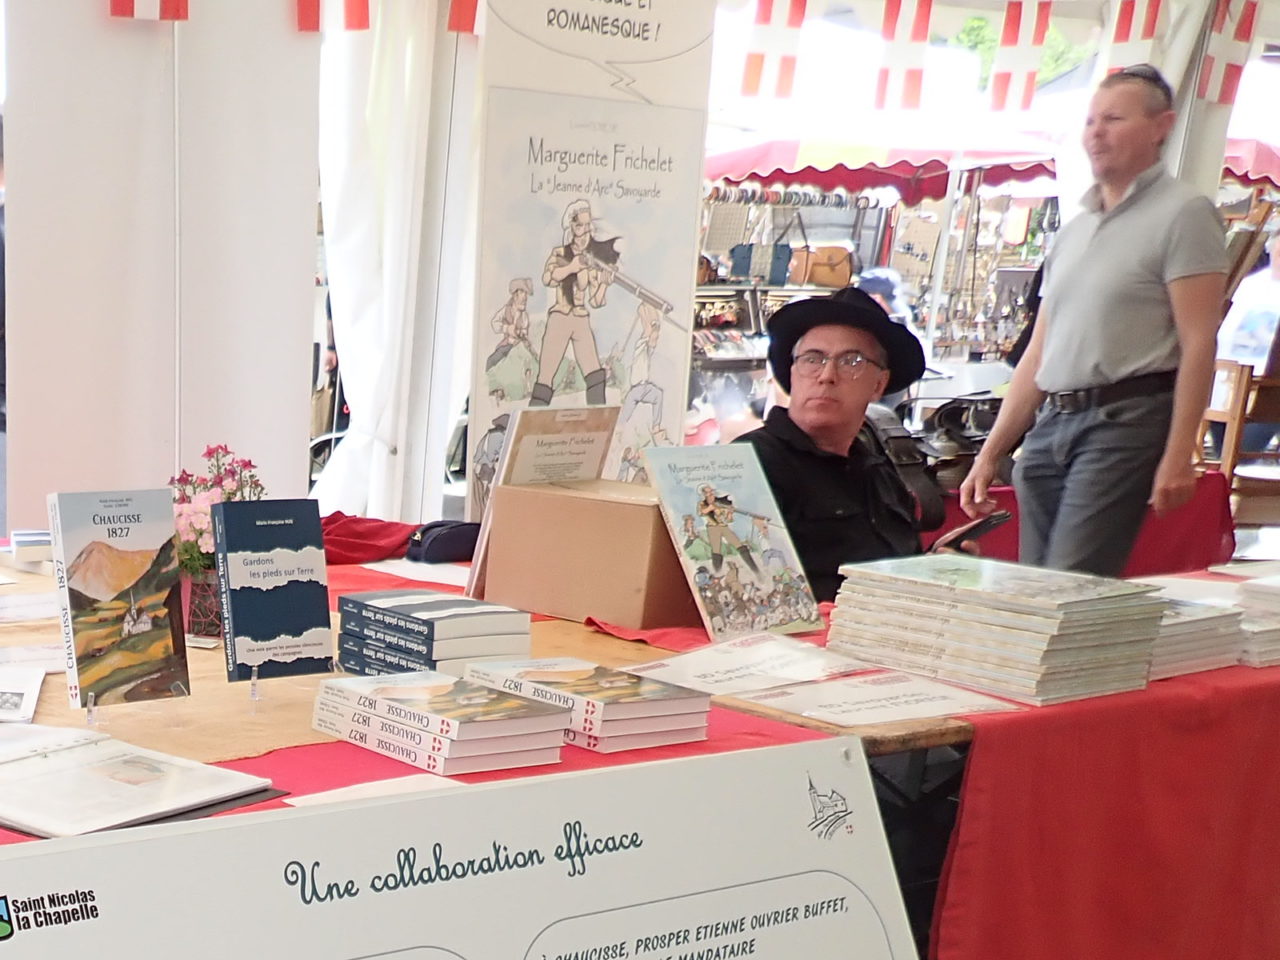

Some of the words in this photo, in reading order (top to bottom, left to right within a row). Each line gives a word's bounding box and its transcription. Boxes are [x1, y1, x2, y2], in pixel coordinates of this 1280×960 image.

[547, 8, 650, 41] ROMANESQUE
[654, 23, 661, 42] !
[527, 136, 608, 173] Marguerite
[612, 143, 673, 173] Frichelet
[530, 173, 543, 194] La
[614, 179, 661, 203] Savoyarde
[92, 513, 143, 525] CHAUCISSE
[106, 527, 131, 538] 1827
[242, 558, 274, 567] Gardons
[249, 569, 261, 578] les
[262, 568, 283, 580] pieds
[284, 569, 295, 577] sur
[297, 567, 314, 576] Terre
[57, 560, 66, 590] 1827
[221, 594, 229, 618] pieds
[406, 622, 428, 634] Gardons
[225, 634, 234, 672] Gardons
[502, 678, 522, 693] 1827
[357, 695, 377, 710] 1827
[532, 687, 575, 711] CHAUCISSE
[351, 712, 371, 728] 1827
[387, 704, 430, 728] CHAUCISSE
[348, 728, 367, 744] 1827
[380, 721, 422, 745] CHAUCISSE
[376, 738, 417, 763] CHAUCISSE
[283, 860, 360, 905] Une
[369, 840, 546, 893] collaboration
[553, 820, 644, 878] efficace
[11, 896, 47, 918] Saint
[47, 889, 96, 909] Nicolas
[15, 915, 32, 931] la
[32, 904, 99, 928] Chapelle
[634, 928, 691, 956] PROSPER
[695, 916, 746, 943] ETIENNE
[750, 906, 799, 931] OUVRIER
[803, 896, 849, 920] BUFFET,
